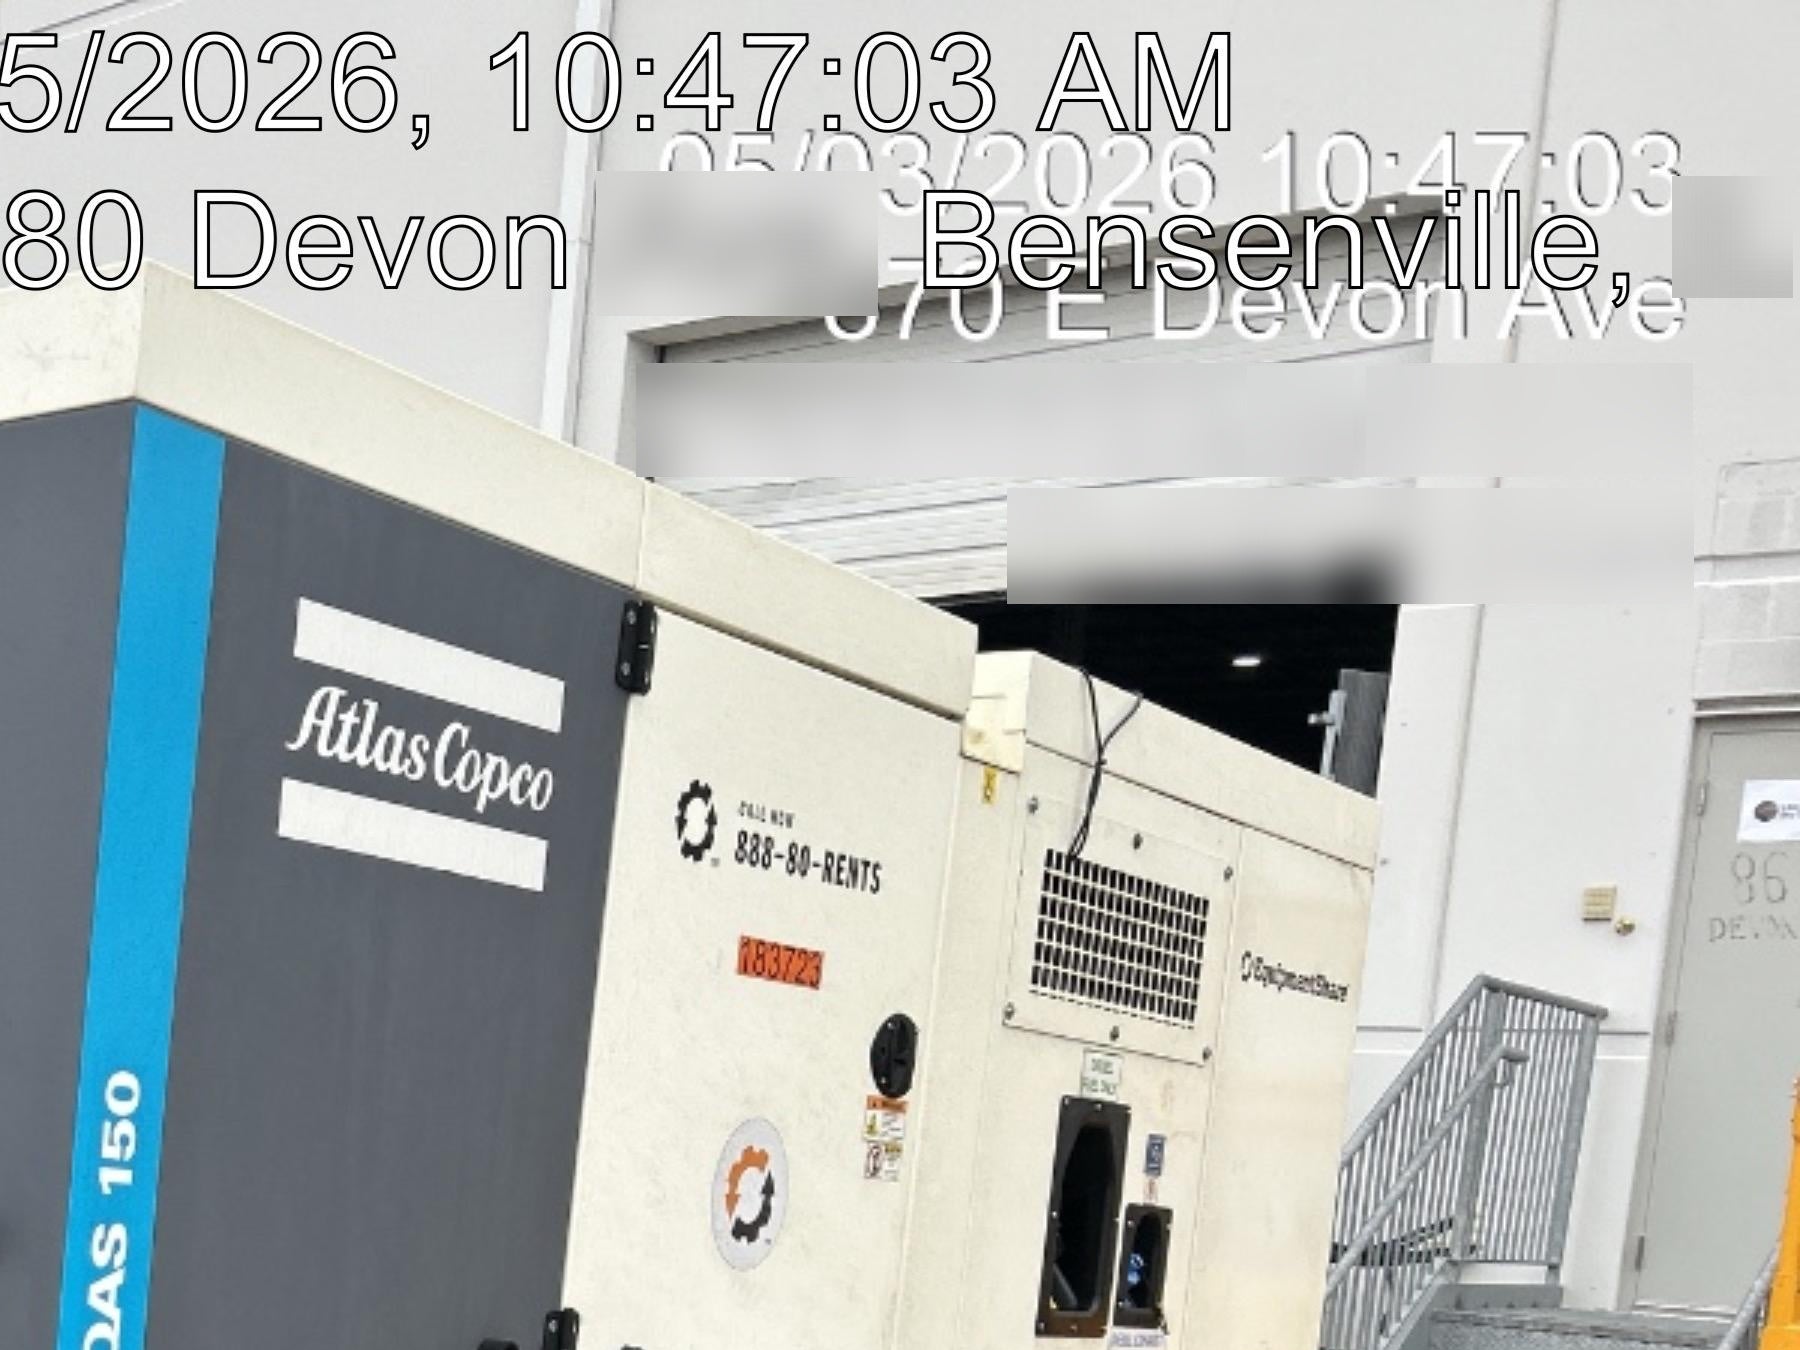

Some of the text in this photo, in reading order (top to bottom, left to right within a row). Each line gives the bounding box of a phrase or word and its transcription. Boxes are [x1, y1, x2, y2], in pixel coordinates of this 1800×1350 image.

[284, 686, 554, 814] Atlas Copco
[735, 829, 883, 895] 888-80-RENTS
[98, 1069, 141, 1195] 150
